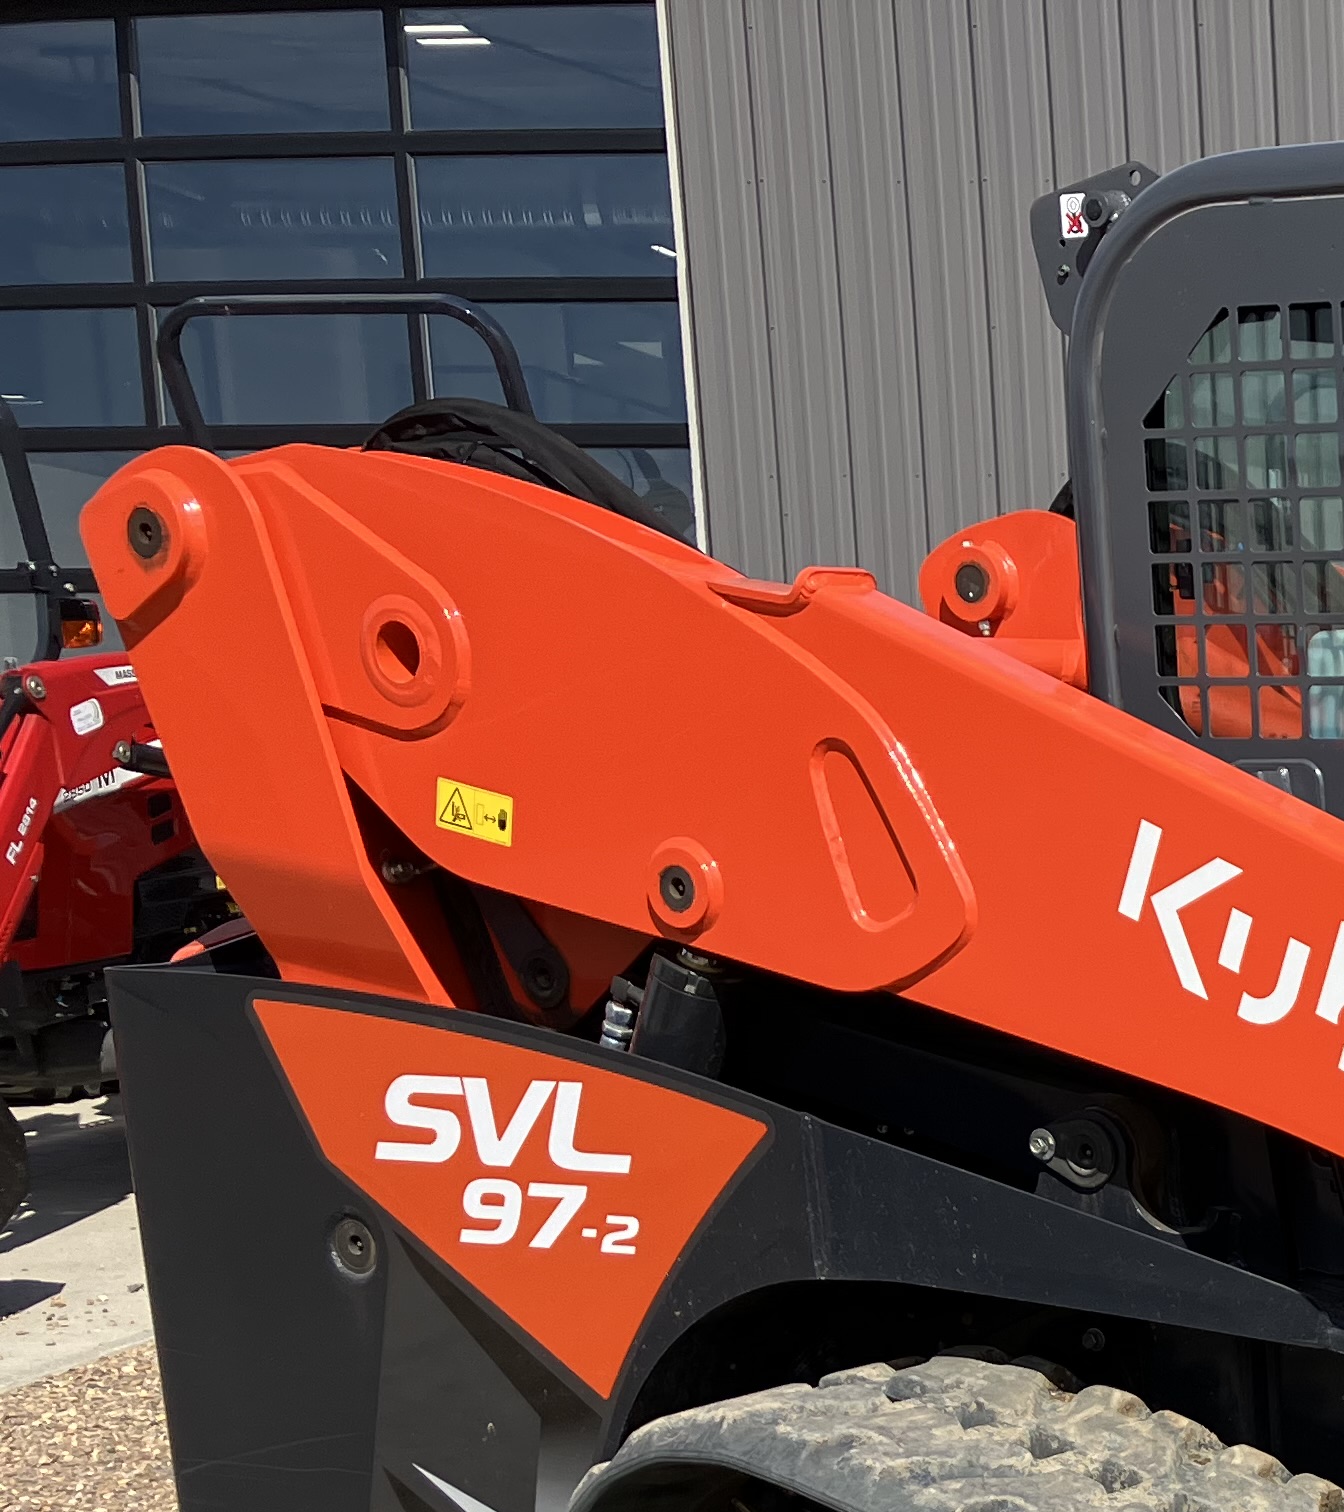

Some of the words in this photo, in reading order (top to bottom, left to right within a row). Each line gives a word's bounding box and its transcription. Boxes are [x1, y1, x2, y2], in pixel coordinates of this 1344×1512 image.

[5, 840, 24, 865] FL
[374, 1074, 632, 1174] SVL
[459, 1178, 640, 1255] 97-2
